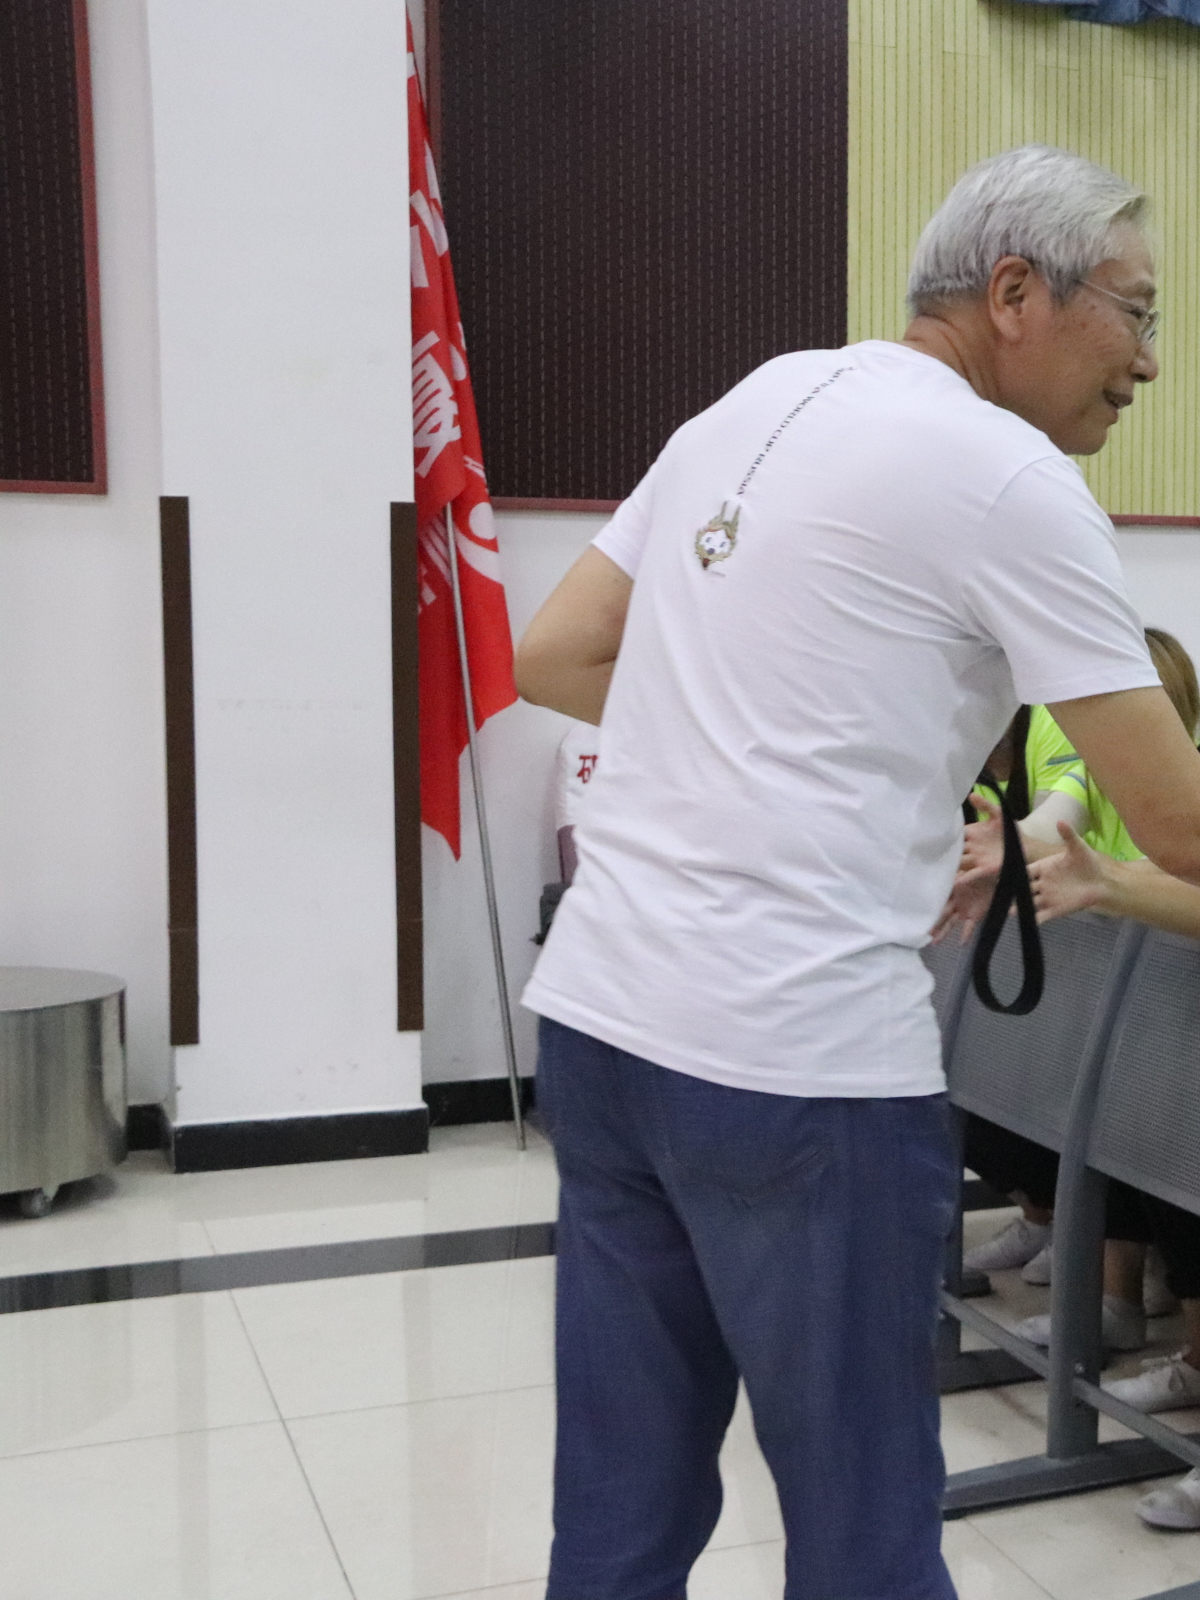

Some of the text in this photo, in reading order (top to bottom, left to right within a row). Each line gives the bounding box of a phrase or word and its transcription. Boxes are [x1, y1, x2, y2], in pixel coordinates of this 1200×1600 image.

[779, 395, 815, 429] WORLD
[764, 428, 783, 453] CUP
[735, 452, 766, 496] RUSSIA
